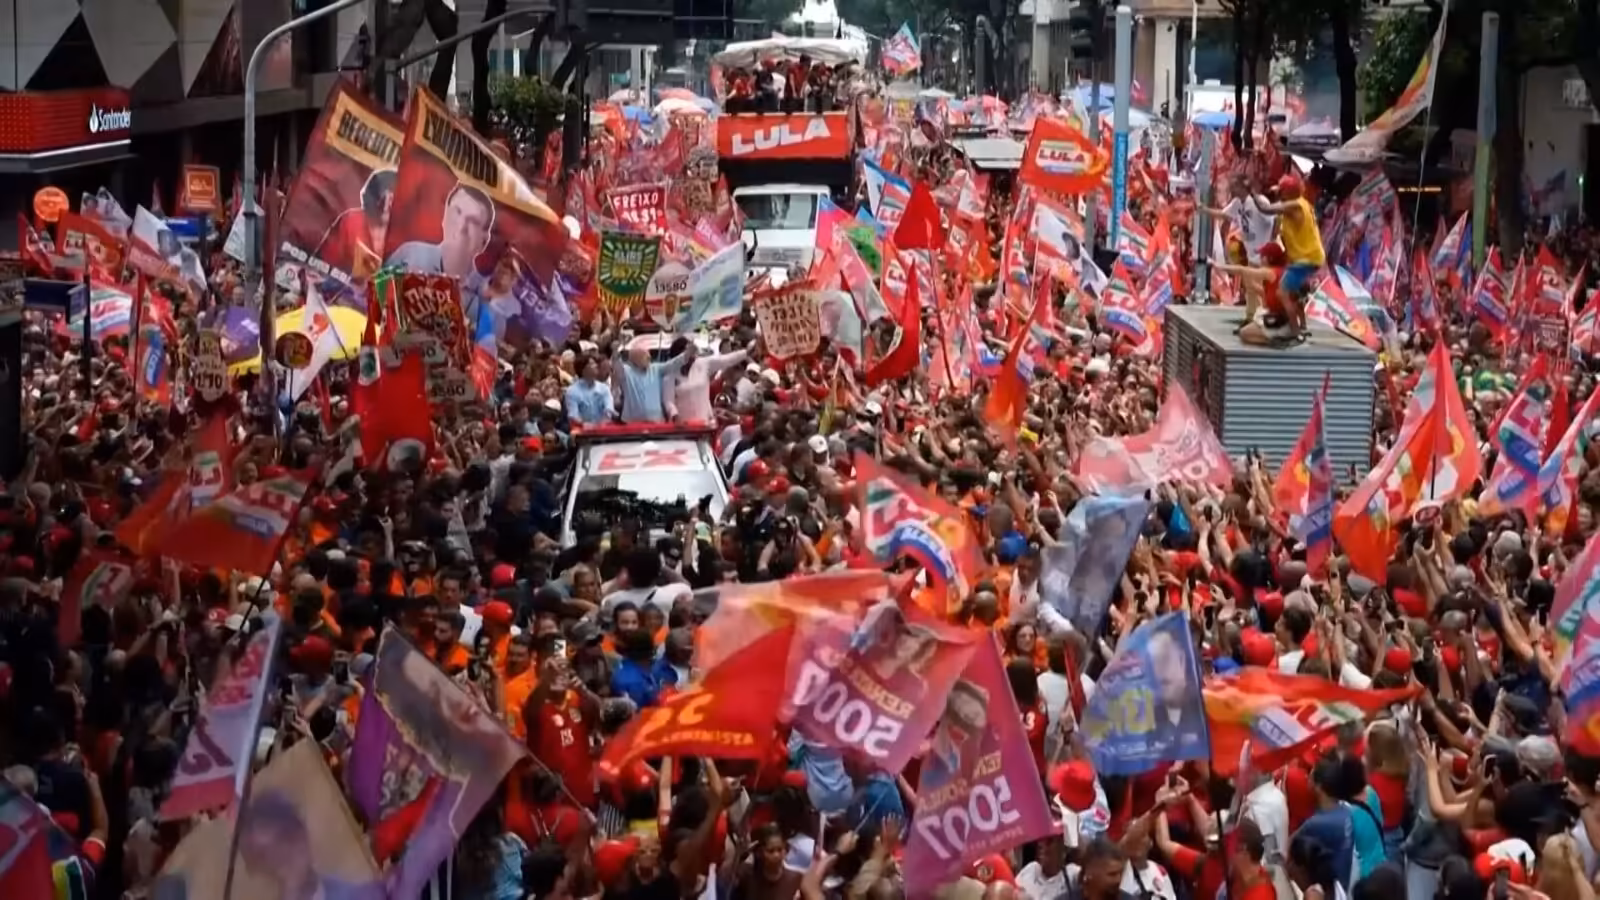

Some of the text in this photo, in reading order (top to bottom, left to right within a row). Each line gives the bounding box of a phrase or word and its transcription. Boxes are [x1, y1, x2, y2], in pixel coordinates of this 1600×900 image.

[98, 106, 132, 132] Santander
[731, 118, 832, 156] LULA
[1038, 148, 1085, 162] LULA
[613, 192, 659, 210] FREIXO
